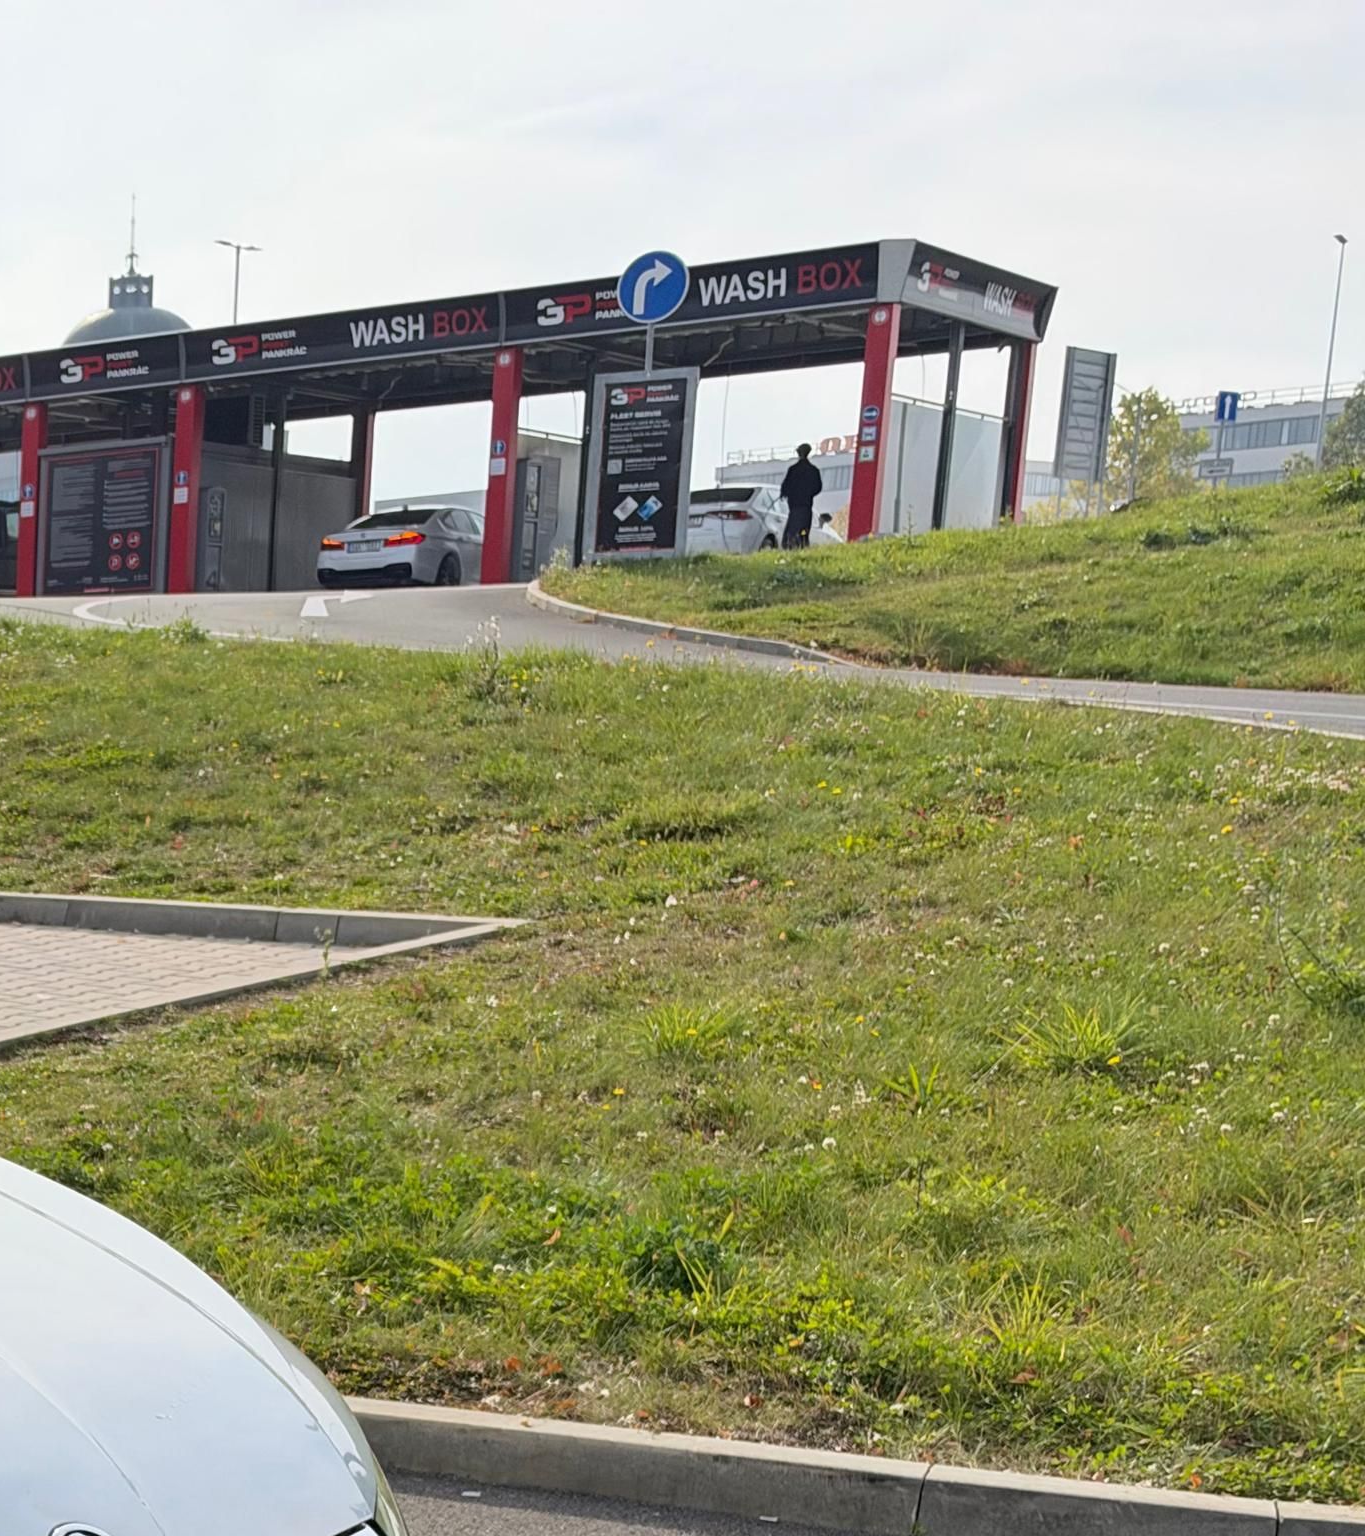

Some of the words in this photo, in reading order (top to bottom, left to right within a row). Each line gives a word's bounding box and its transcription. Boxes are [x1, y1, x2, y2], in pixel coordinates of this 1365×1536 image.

[698, 267, 787, 307] WASH
[797, 259, 862, 293] BOX
[983, 281, 1017, 317] WASH
[261, 330, 296, 341] POWER
[349, 313, 425, 348] WASH
[432, 307, 489, 338] BOX
[106, 350, 139, 361] POWER
